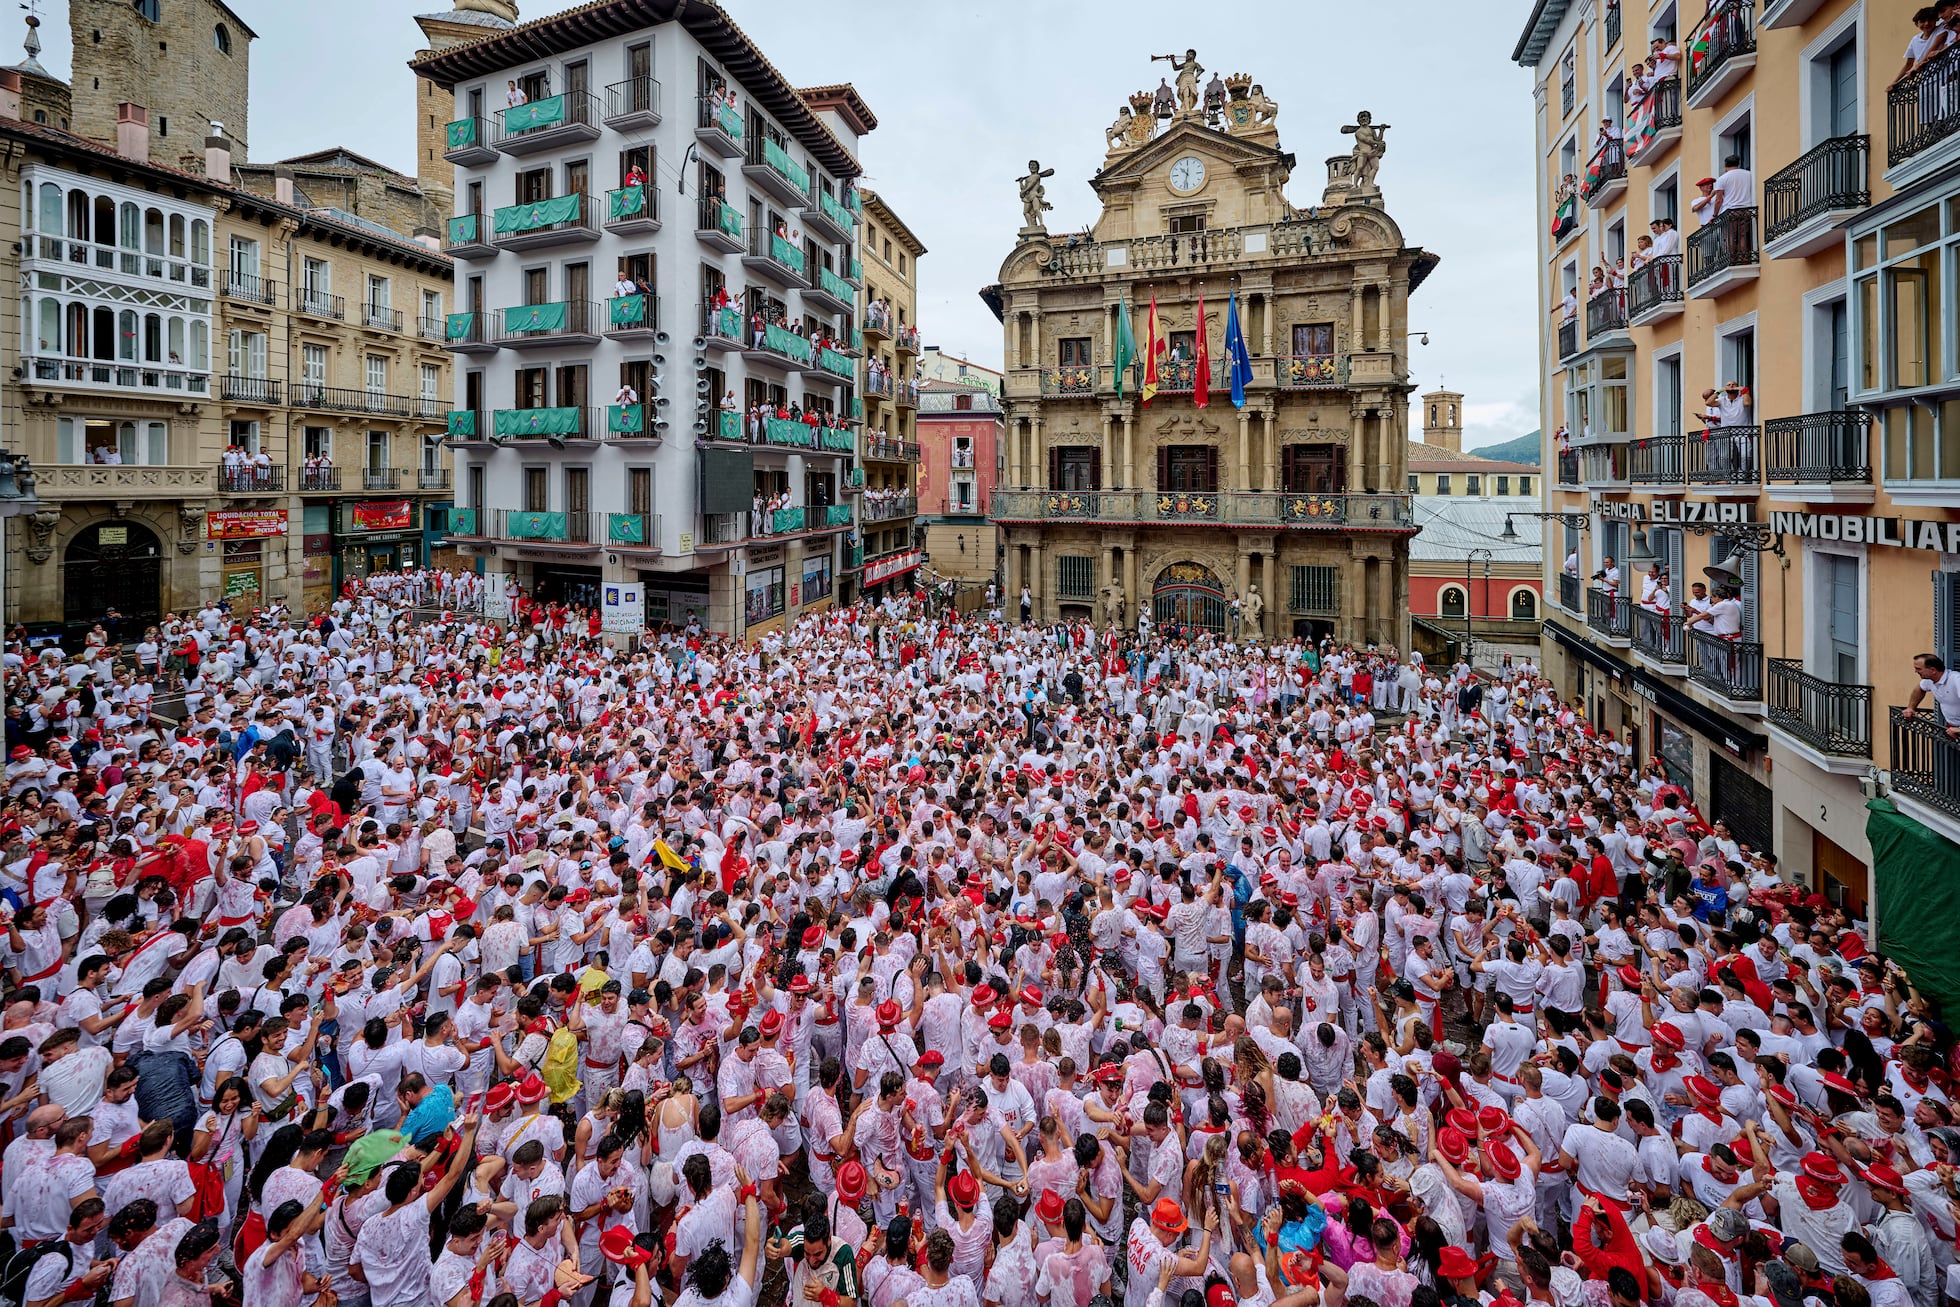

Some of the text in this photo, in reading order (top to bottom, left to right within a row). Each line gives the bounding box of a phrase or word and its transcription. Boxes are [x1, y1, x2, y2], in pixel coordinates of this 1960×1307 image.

[217, 511, 258, 519] LIQUIDACIÓN
[1590, 500, 1748, 523] AGENCIA ELIZARI
[1633, 679, 1645, 695] BAR
[1820, 804, 1828, 822] 2
